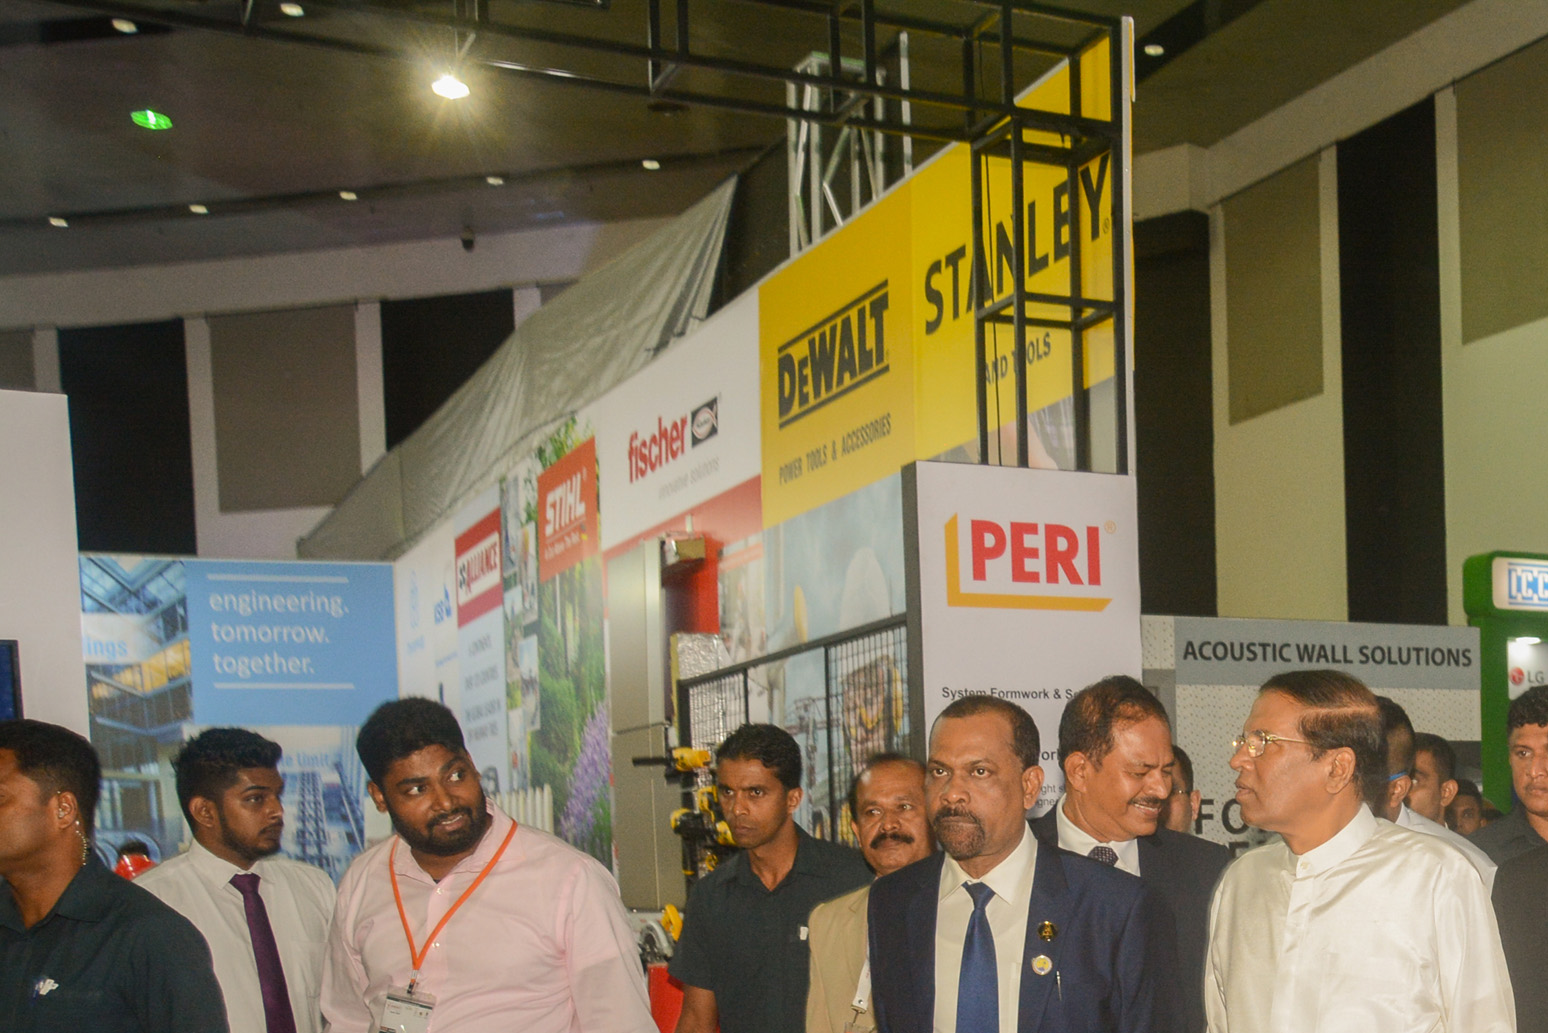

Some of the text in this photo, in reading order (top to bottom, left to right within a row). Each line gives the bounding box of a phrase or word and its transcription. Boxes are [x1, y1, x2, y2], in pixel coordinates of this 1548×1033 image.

[628, 414, 688, 484] fischer
[806, 444, 827, 472] TOOLS
[841, 412, 891, 455] ACCESSORIES
[545, 471, 586, 538] STIHL
[970, 518, 1102, 587] PERI
[208, 589, 350, 618] engineering.
[210, 621, 330, 643] tomorrow.
[213, 651, 315, 679] together.
[1183, 640, 1472, 667] ACOUSTIC WALL SOLUTIONS
[942, 686, 987, 701] System
[990, 687, 1050, 700] Formwork
[1053, 688, 1061, 699] &
